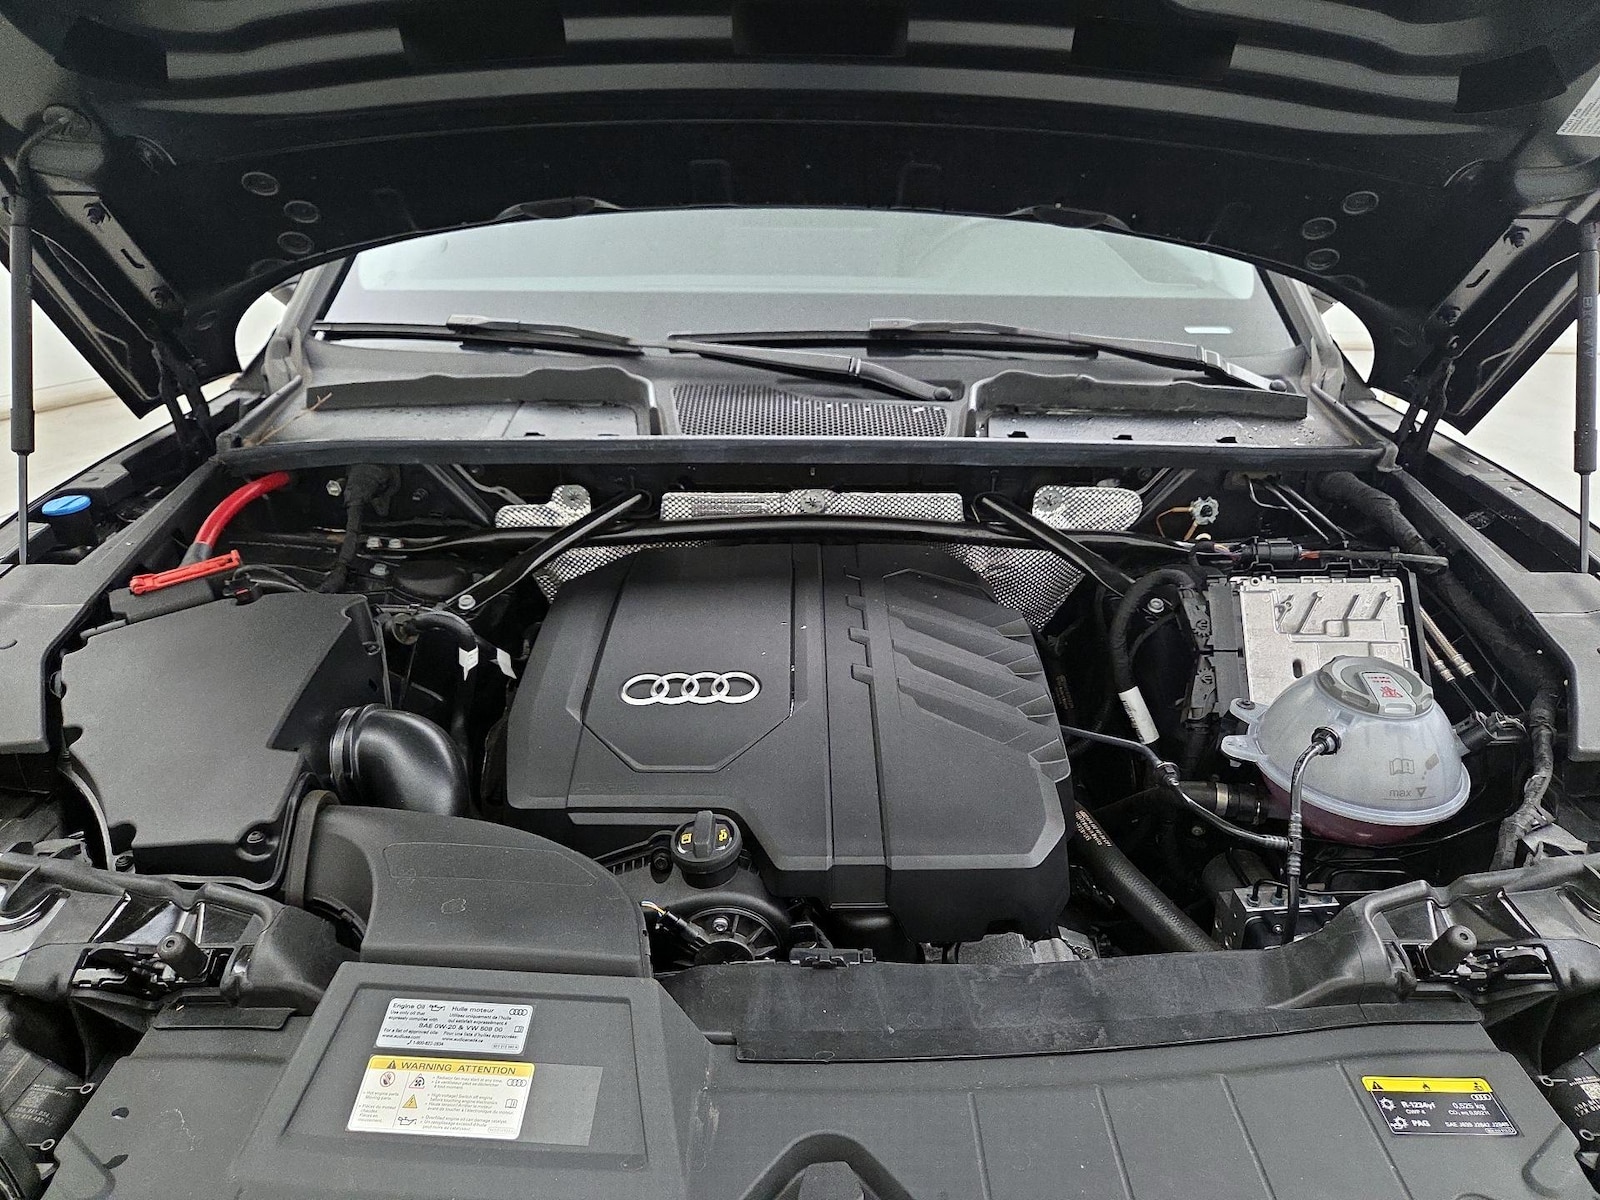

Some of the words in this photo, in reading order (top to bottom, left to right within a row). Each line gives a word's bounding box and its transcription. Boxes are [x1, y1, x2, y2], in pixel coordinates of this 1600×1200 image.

[1389, 788, 1412, 797] max
[401, 1062, 452, 1072] WARNING
[456, 1065, 516, 1075] ATTENTION
[1401, 1101, 1436, 1109] R-1234yf
